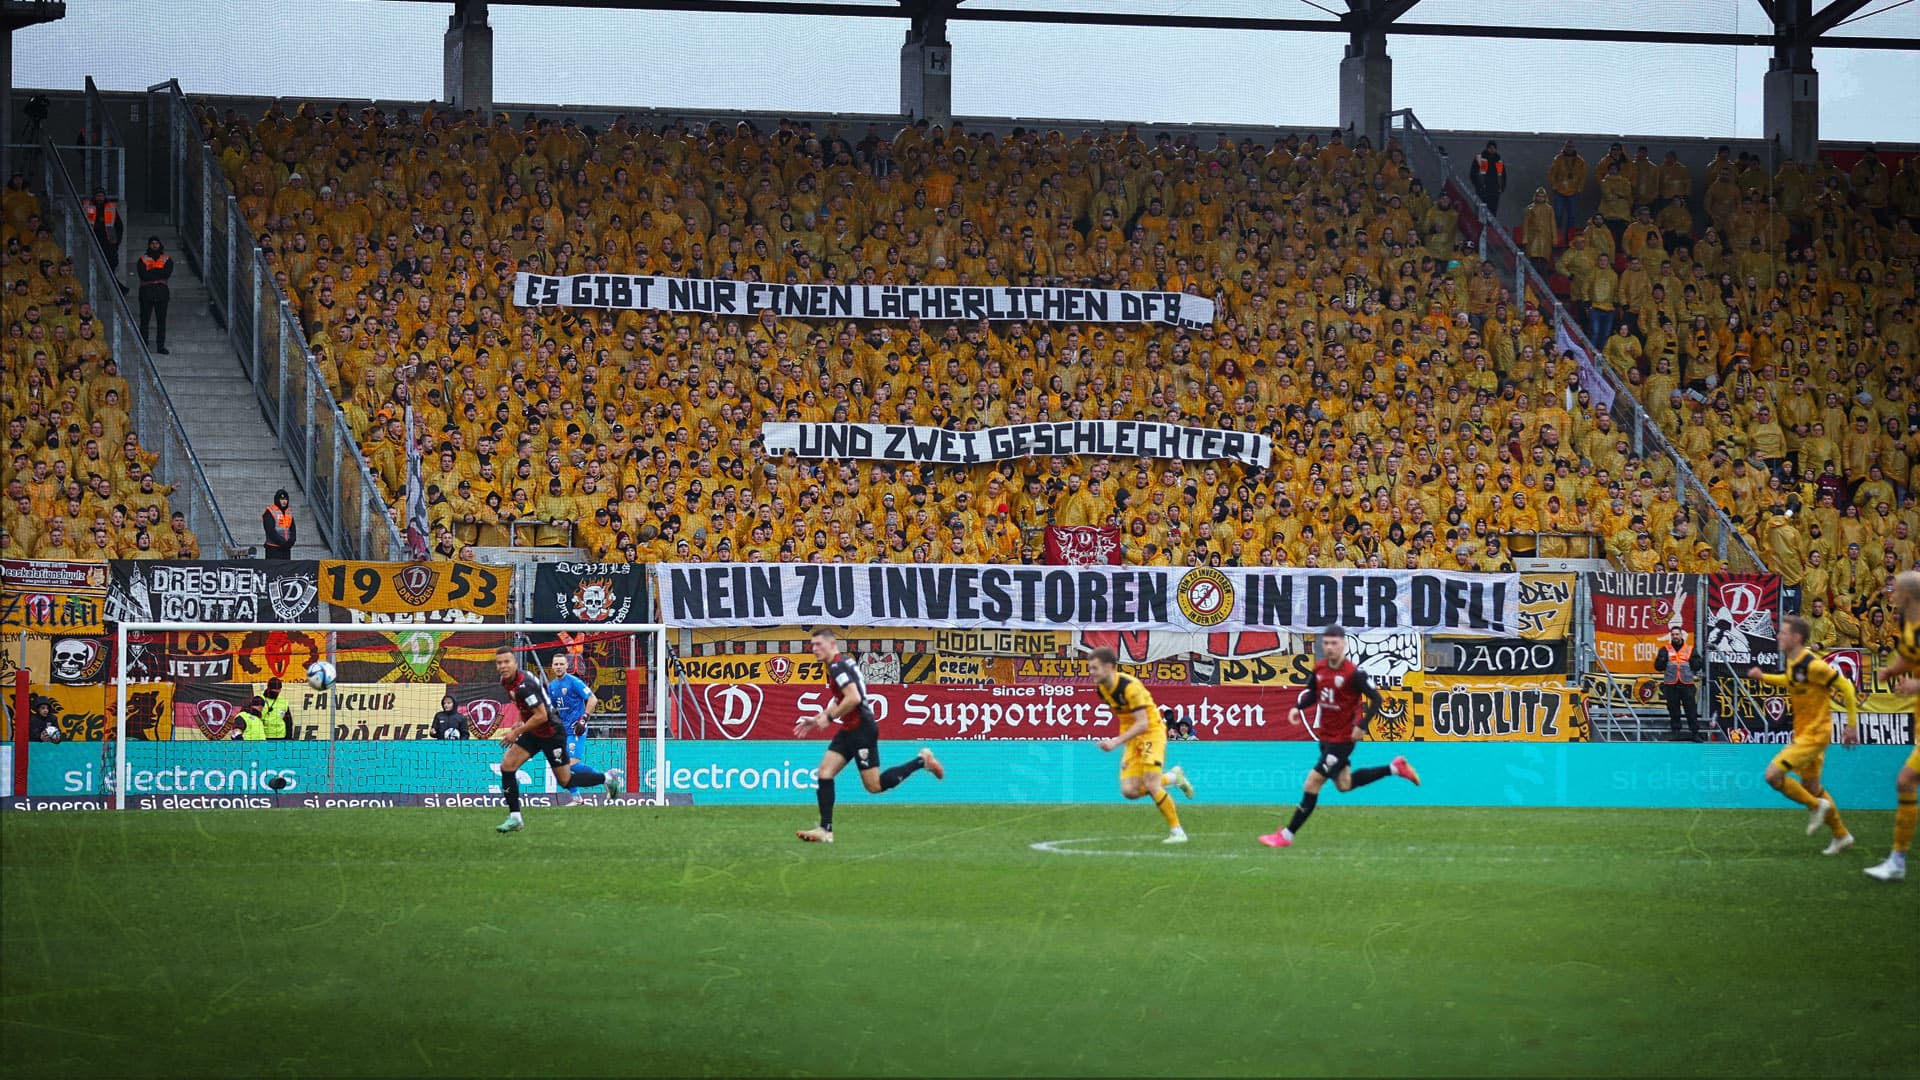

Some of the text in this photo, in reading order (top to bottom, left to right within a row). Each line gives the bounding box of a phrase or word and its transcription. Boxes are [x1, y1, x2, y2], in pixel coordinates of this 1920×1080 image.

[526, 276, 559, 305] ES
[571, 275, 655, 307] GIBT
[668, 279, 736, 313] NUR
[747, 283, 851, 316] EINEN
[863, 285, 1108, 321] LÄCHERLICHEN
[884, 426, 979, 462] ZWEI
[990, 420, 1260, 467] GESCHLECHTER!
[555, 561, 631, 575] DEVILS
[151, 567, 268, 595] DRESDEN
[327, 563, 499, 608] 19 53
[1199, 569, 1232, 594] INVESTOREN
[1595, 571, 1686, 596] SCHNELLER
[399, 586, 434, 606] DRESDEN
[671, 565, 1506, 632] NEIN ZU INVESTOREN IN DER DFL!
[162, 596, 255, 623] COTTA
[273, 599, 307, 620] DRESDEN
[1196, 615, 1209, 624] DER
[1606, 602, 1652, 629] HASE
[936, 630, 1056, 653] HOOLIGANS
[1599, 640, 1625, 662] SEIT
[167, 658, 231, 678] JETZT
[939, 660, 979, 675] CREW
[1710, 650, 1751, 664] RESDEN
[399, 659, 440, 684] DRESDEN
[673, 661, 824, 681] BRIGADE 53
[1018, 659, 1188, 681] AKTIST 53
[992, 684, 1075, 698] since 1998
[902, 694, 1114, 735] Supporters
[1157, 696, 1267, 736] utzen
[1431, 685, 1562, 736] GÖRLITZ
[1831, 712, 1909, 745] DETSCHE
[63, 762, 92, 792] si
[140, 795, 272, 810] si electronics
[424, 794, 441, 808] si
